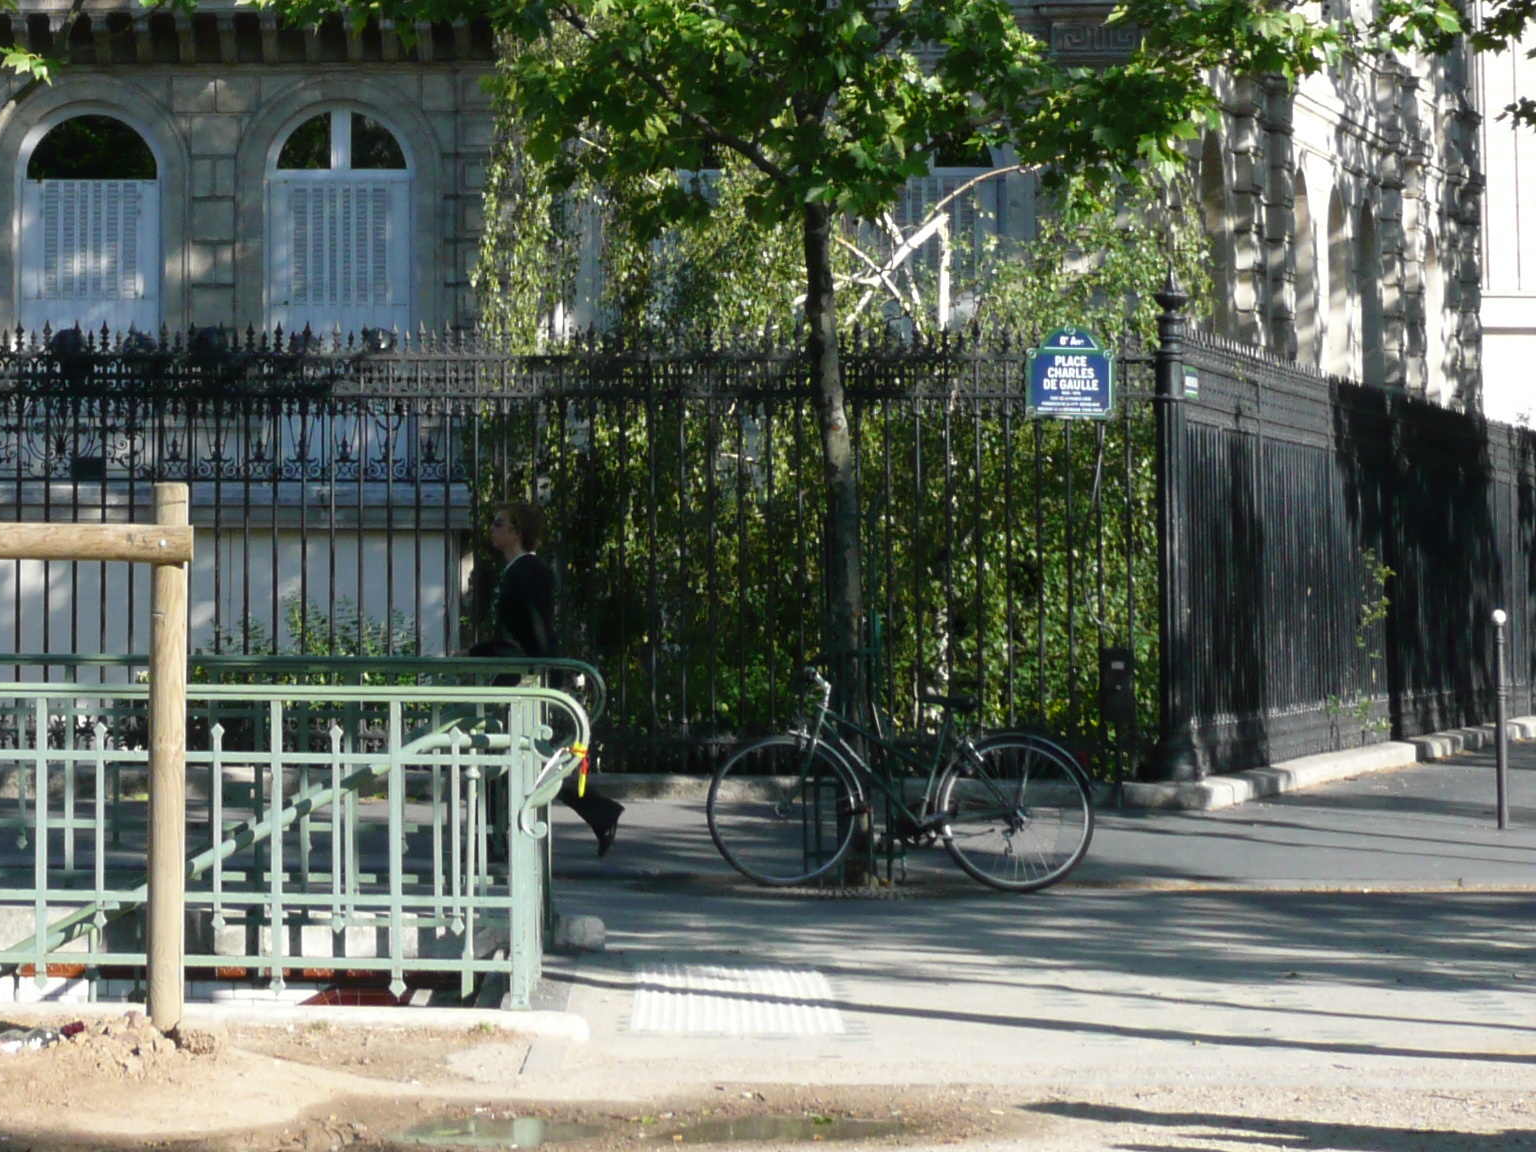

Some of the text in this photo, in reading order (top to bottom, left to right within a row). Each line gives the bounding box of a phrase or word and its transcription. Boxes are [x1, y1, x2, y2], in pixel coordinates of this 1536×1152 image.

[1055, 355, 1088, 367] PLACE
[1047, 367, 1095, 379] CHARLES
[1043, 379, 1099, 391] DE GAULLE
